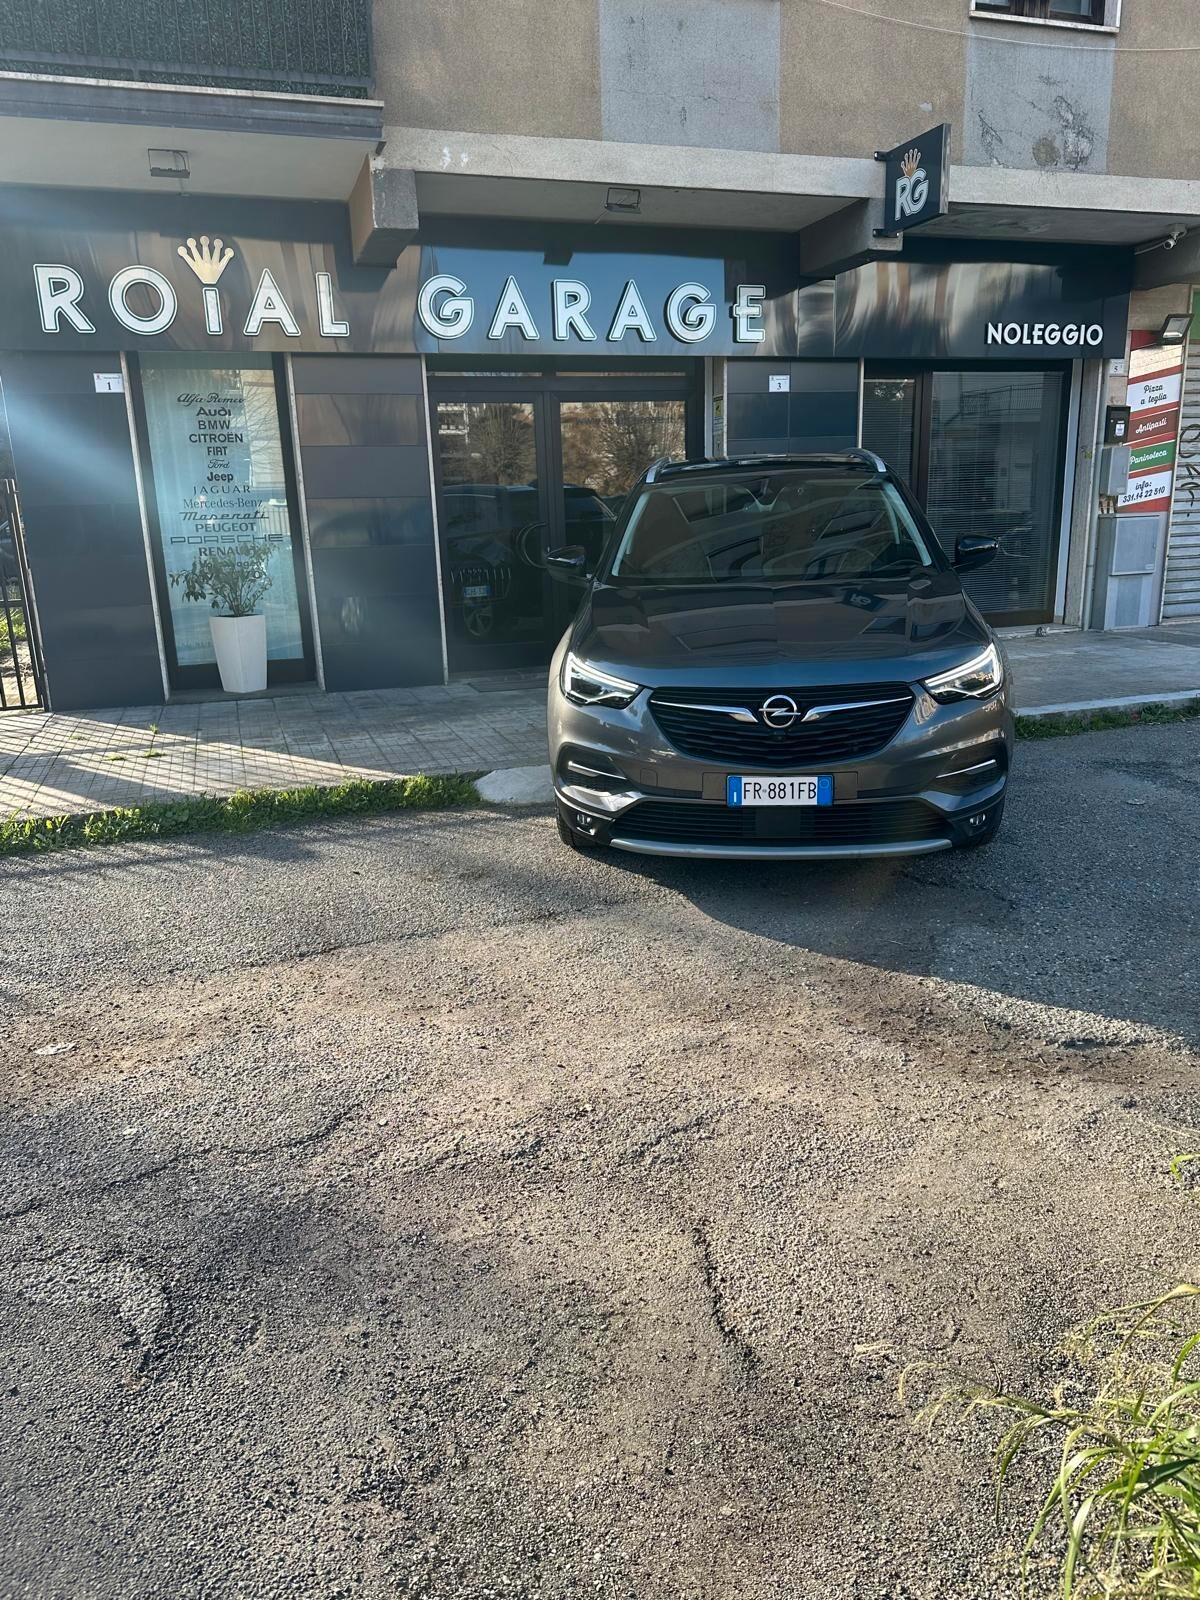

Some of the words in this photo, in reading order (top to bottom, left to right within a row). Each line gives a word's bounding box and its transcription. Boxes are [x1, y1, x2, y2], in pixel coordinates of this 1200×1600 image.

[895, 168, 929, 221] RG
[418, 274, 767, 343] GARAGE
[986, 322, 1104, 346] NOLEGGIO
[107, 381, 112, 391] 1
[777, 382, 782, 390] 3
[1143, 385, 1163, 393] Pizza
[177, 393, 203, 407] Alfa
[196, 407, 232, 416] Audi
[198, 420, 230, 430] BMW
[1135, 418, 1168, 434] Antipasti
[189, 432, 243, 443] CITROËN
[207, 446, 228, 456] FIAT
[208, 459, 230, 469] Ford
[207, 472, 234, 483] Jeep
[193, 485, 251, 495] JAGUAR
[1144, 489, 1153, 498] 22
[1154, 486, 1166, 495] 510
[183, 498, 262, 509] Mercedes-Benz
[180, 510, 270, 520] Maserati
[195, 522, 256, 533] PEUGEOT
[170, 534, 283, 544] PORSCHE
